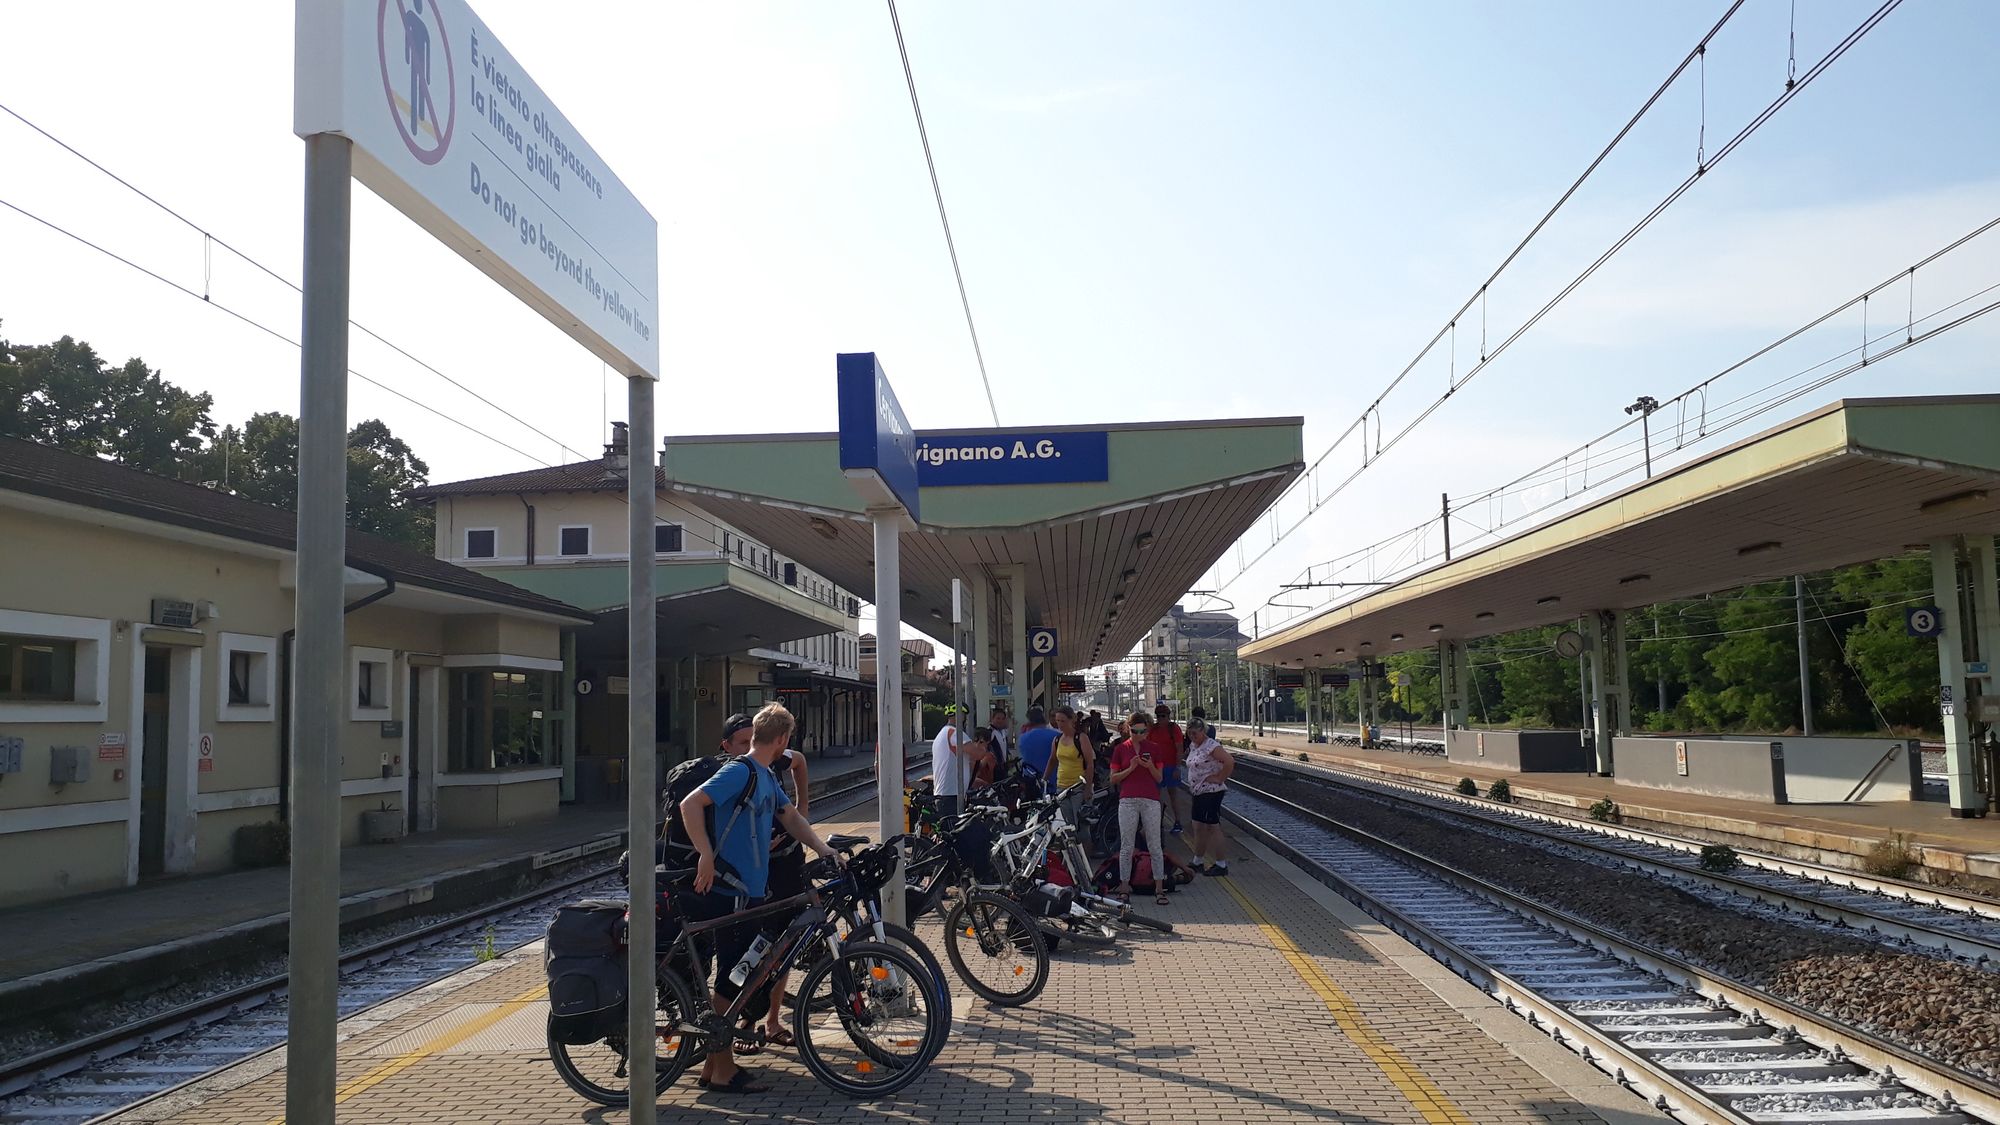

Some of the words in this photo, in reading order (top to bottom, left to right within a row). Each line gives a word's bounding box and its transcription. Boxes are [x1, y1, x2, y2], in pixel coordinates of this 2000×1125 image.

[471, 27, 479, 68] È
[482, 54, 530, 122] vietato
[533, 112, 603, 200] oltrepassare
[471, 75, 485, 116] la
[489, 94, 523, 155] linea
[526, 143, 560, 192] gialla
[470, 161, 491, 205] Do
[494, 192, 517, 228] not
[520, 216, 537, 246] go
[540, 223, 583, 285] beyond
[585, 267, 601, 300] the
[603, 288, 633, 326] yellow
[634, 308, 650, 341] line
[1010, 439, 1061, 459] A.G.
[1038, 635, 1049, 650] 2
[1918, 615, 1930, 629] 3
